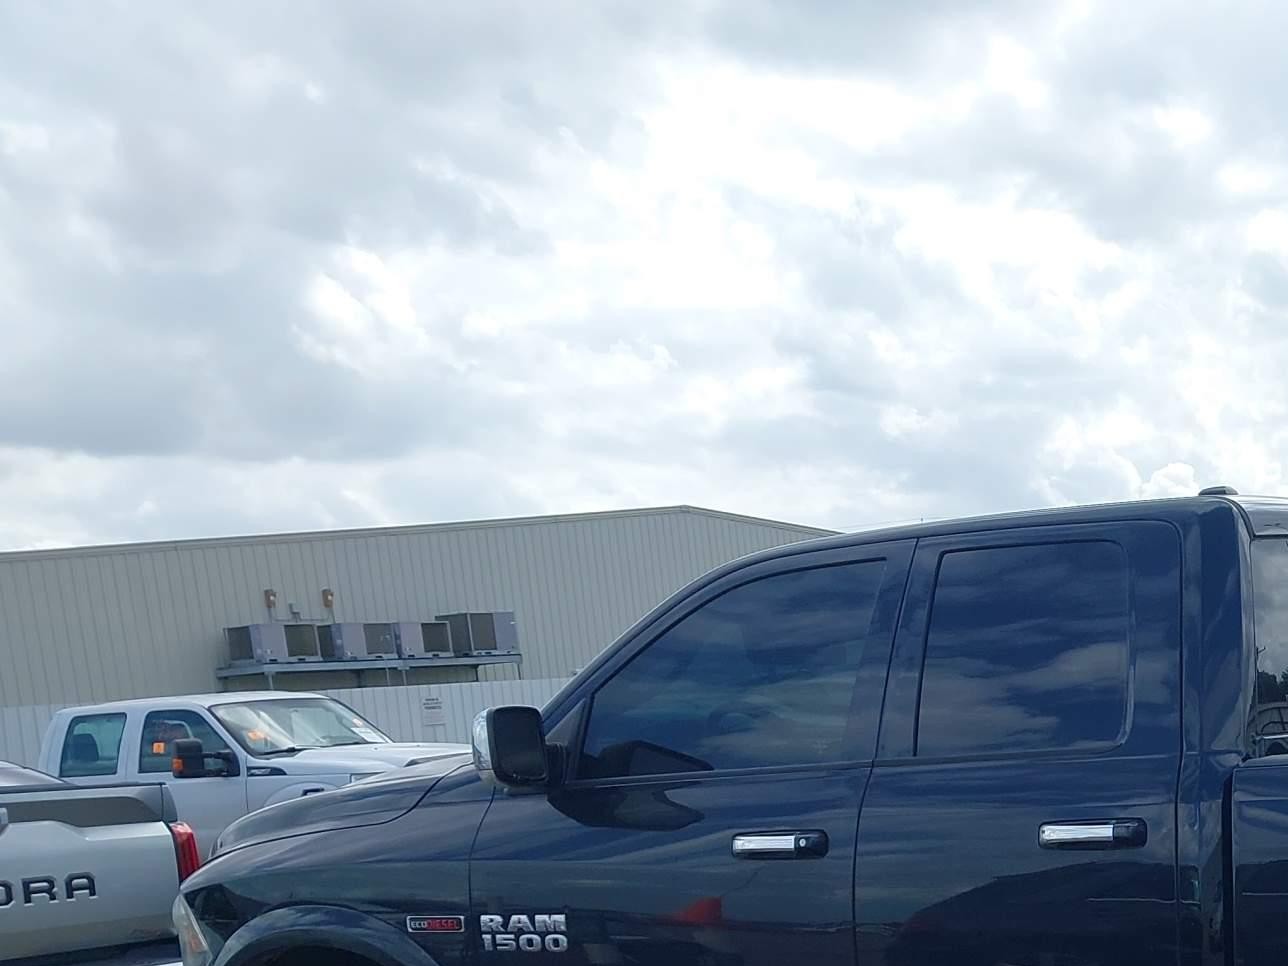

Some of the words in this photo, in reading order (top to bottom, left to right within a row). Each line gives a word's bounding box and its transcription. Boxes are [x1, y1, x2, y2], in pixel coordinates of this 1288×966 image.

[410, 919, 459, 929] ECODIESEL
[480, 914, 568, 932] RAM
[481, 934, 569, 952] 1500
